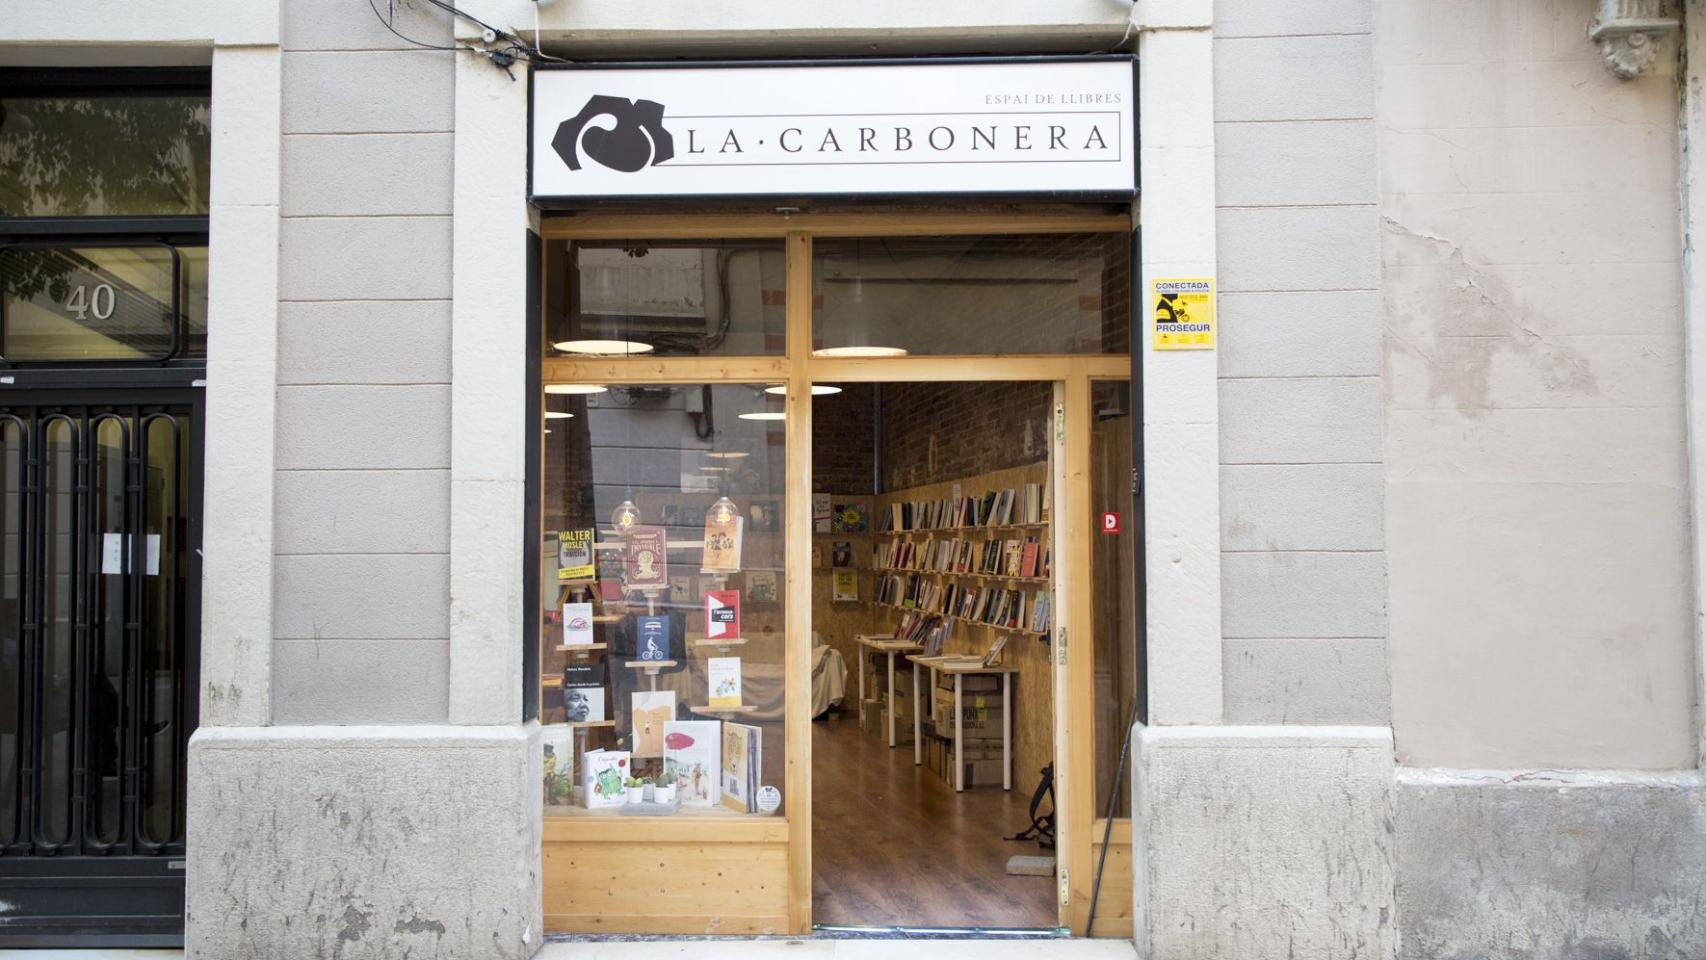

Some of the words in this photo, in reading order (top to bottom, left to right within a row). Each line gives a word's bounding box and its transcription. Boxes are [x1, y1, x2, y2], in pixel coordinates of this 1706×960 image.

[985, 94, 1028, 105] ESPAI
[1035, 94, 1055, 104] DE
[1061, 93, 1122, 104] LLIBRES
[687, 128, 745, 154] LA
[779, 124, 1109, 153] CARBONERA
[66, 284, 116, 320] 40
[1156, 323, 1211, 332] PROSEGUR
[558, 530, 591, 542] WALTER
